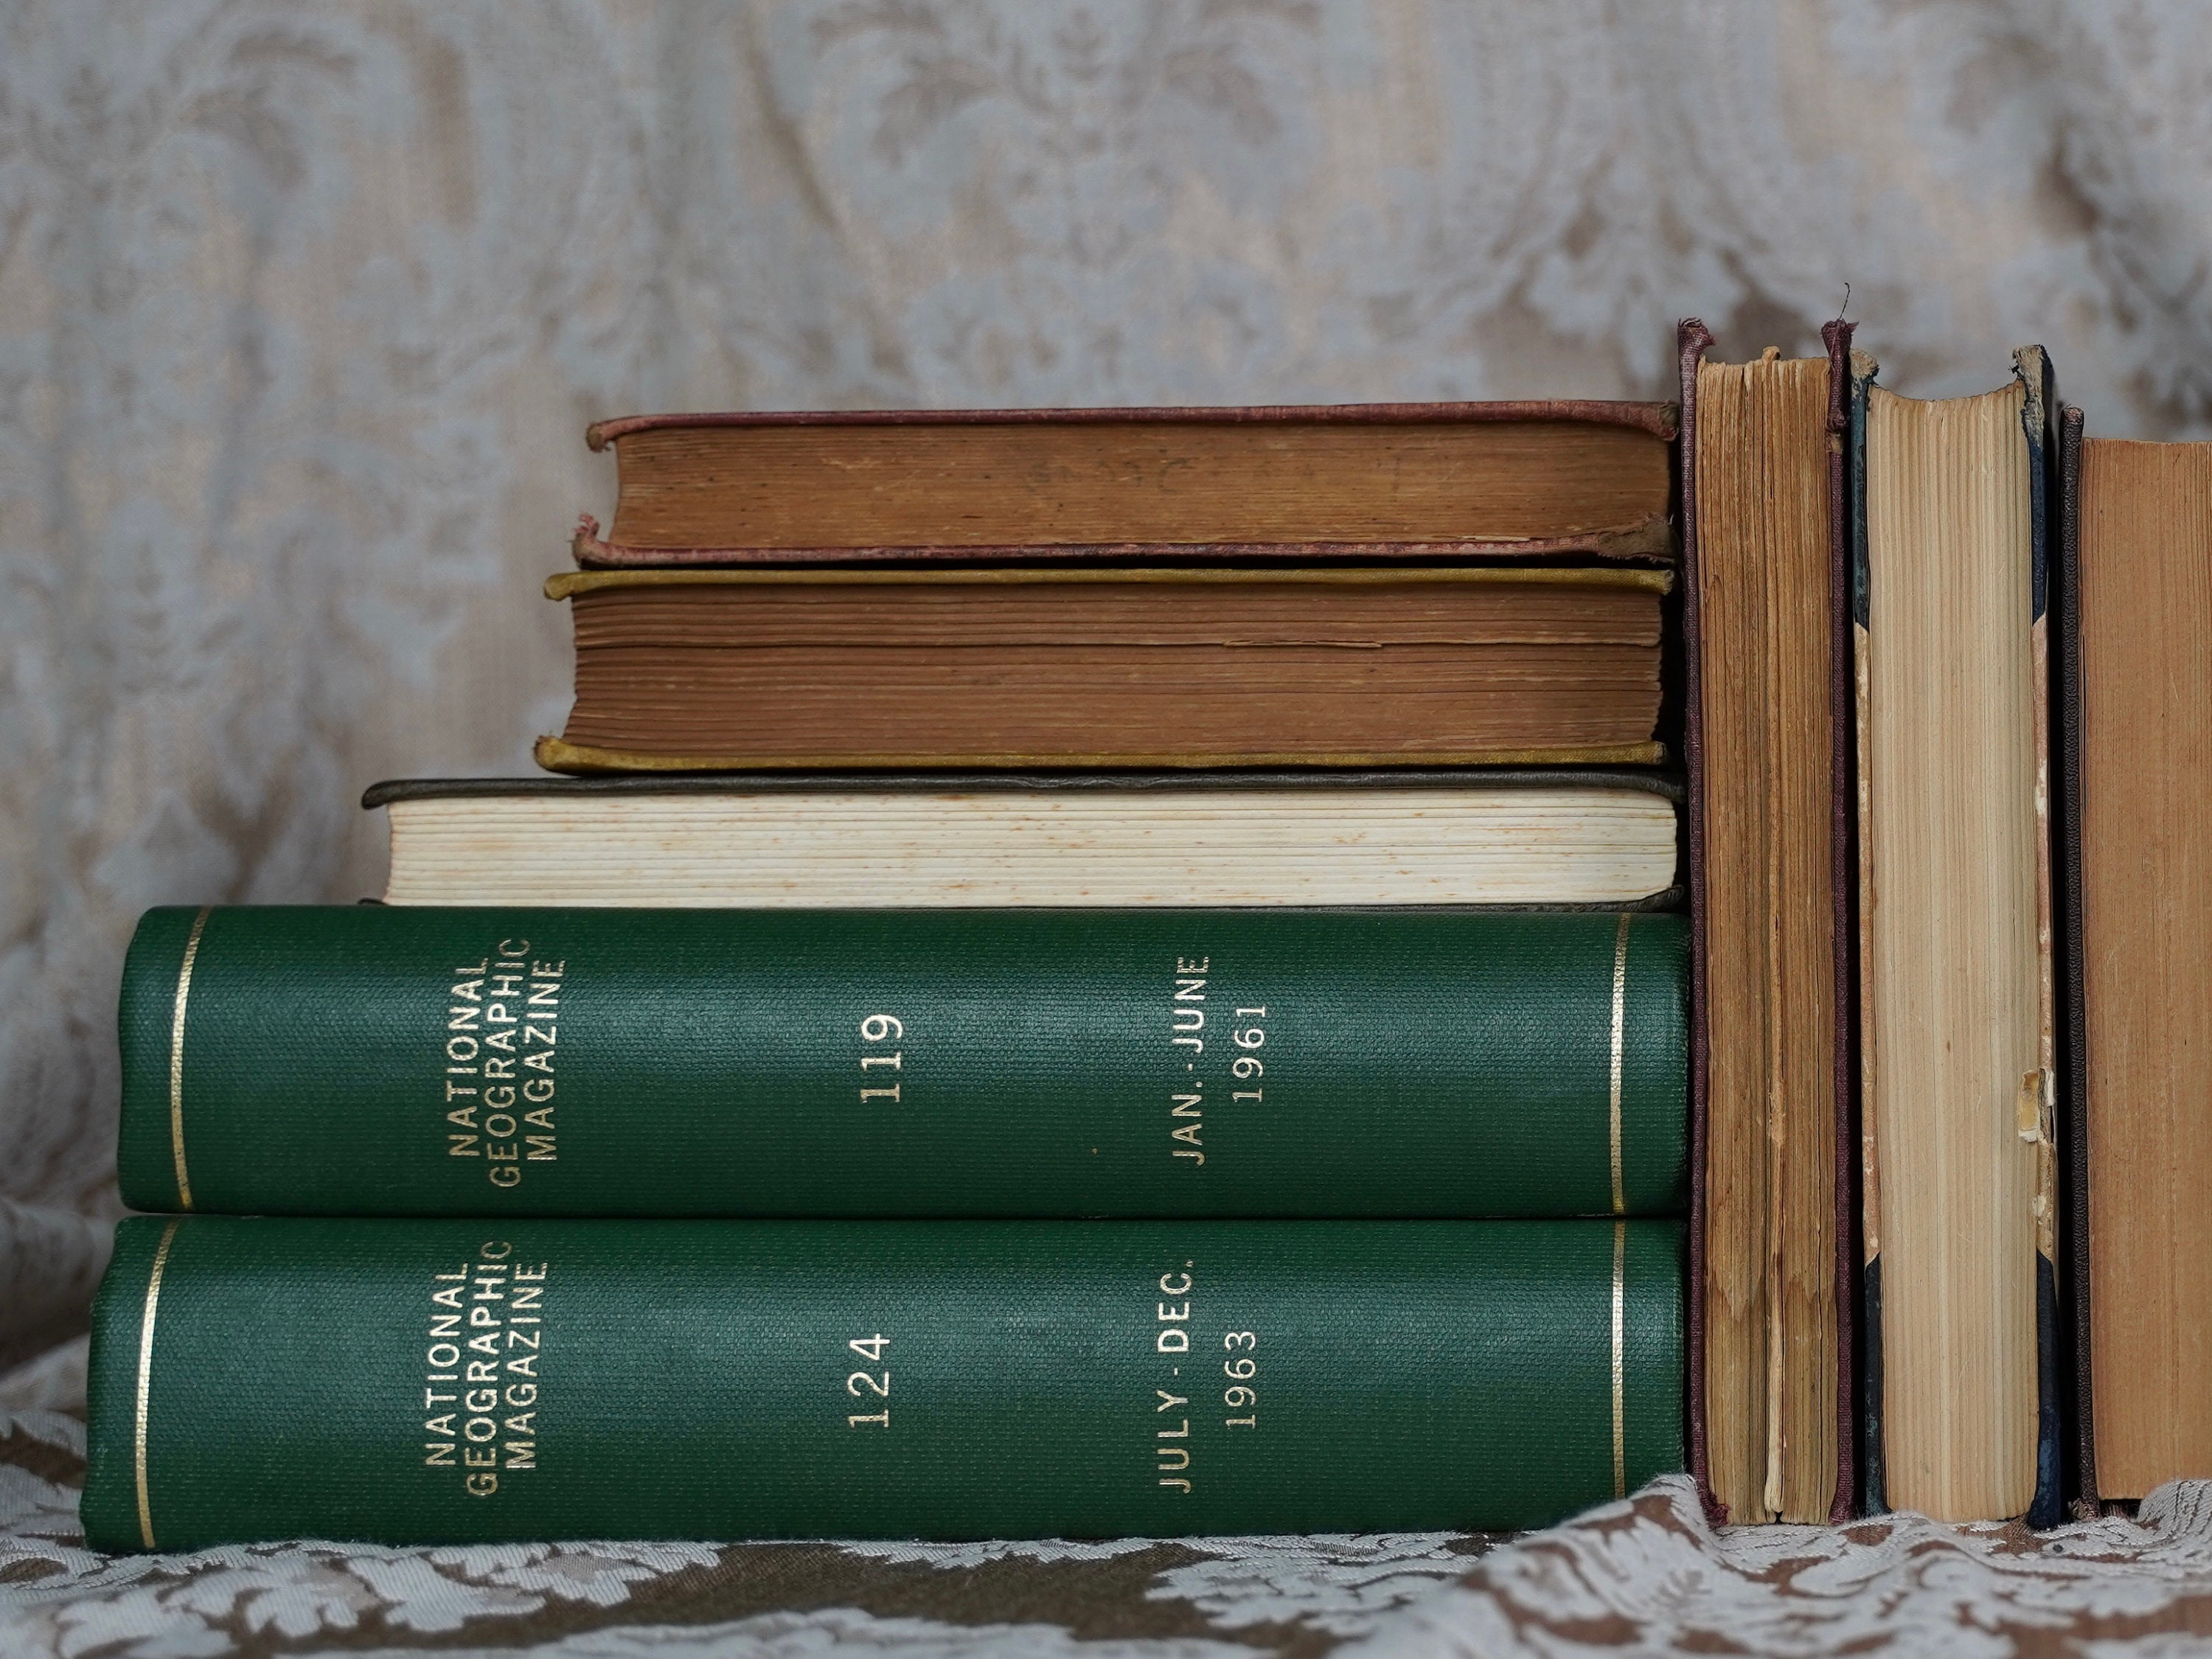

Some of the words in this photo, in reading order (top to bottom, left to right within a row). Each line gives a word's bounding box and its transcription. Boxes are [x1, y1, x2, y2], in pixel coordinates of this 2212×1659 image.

[446, 958, 488, 1156] NATIONAL
[484, 939, 531, 1188] GEOGRAPHIC
[522, 959, 566, 1161] MAGAZINE
[860, 1014, 903, 1103] 119
[1231, 1005, 1266, 1103] 1961
[425, 1262, 469, 1467] NATIONAL
[465, 1241, 512, 1496] GEOGRAPHIC
[505, 1262, 549, 1470] MAGAZINE
[847, 1332, 891, 1429] 124
[1224, 1331, 1256, 1430] 1963
